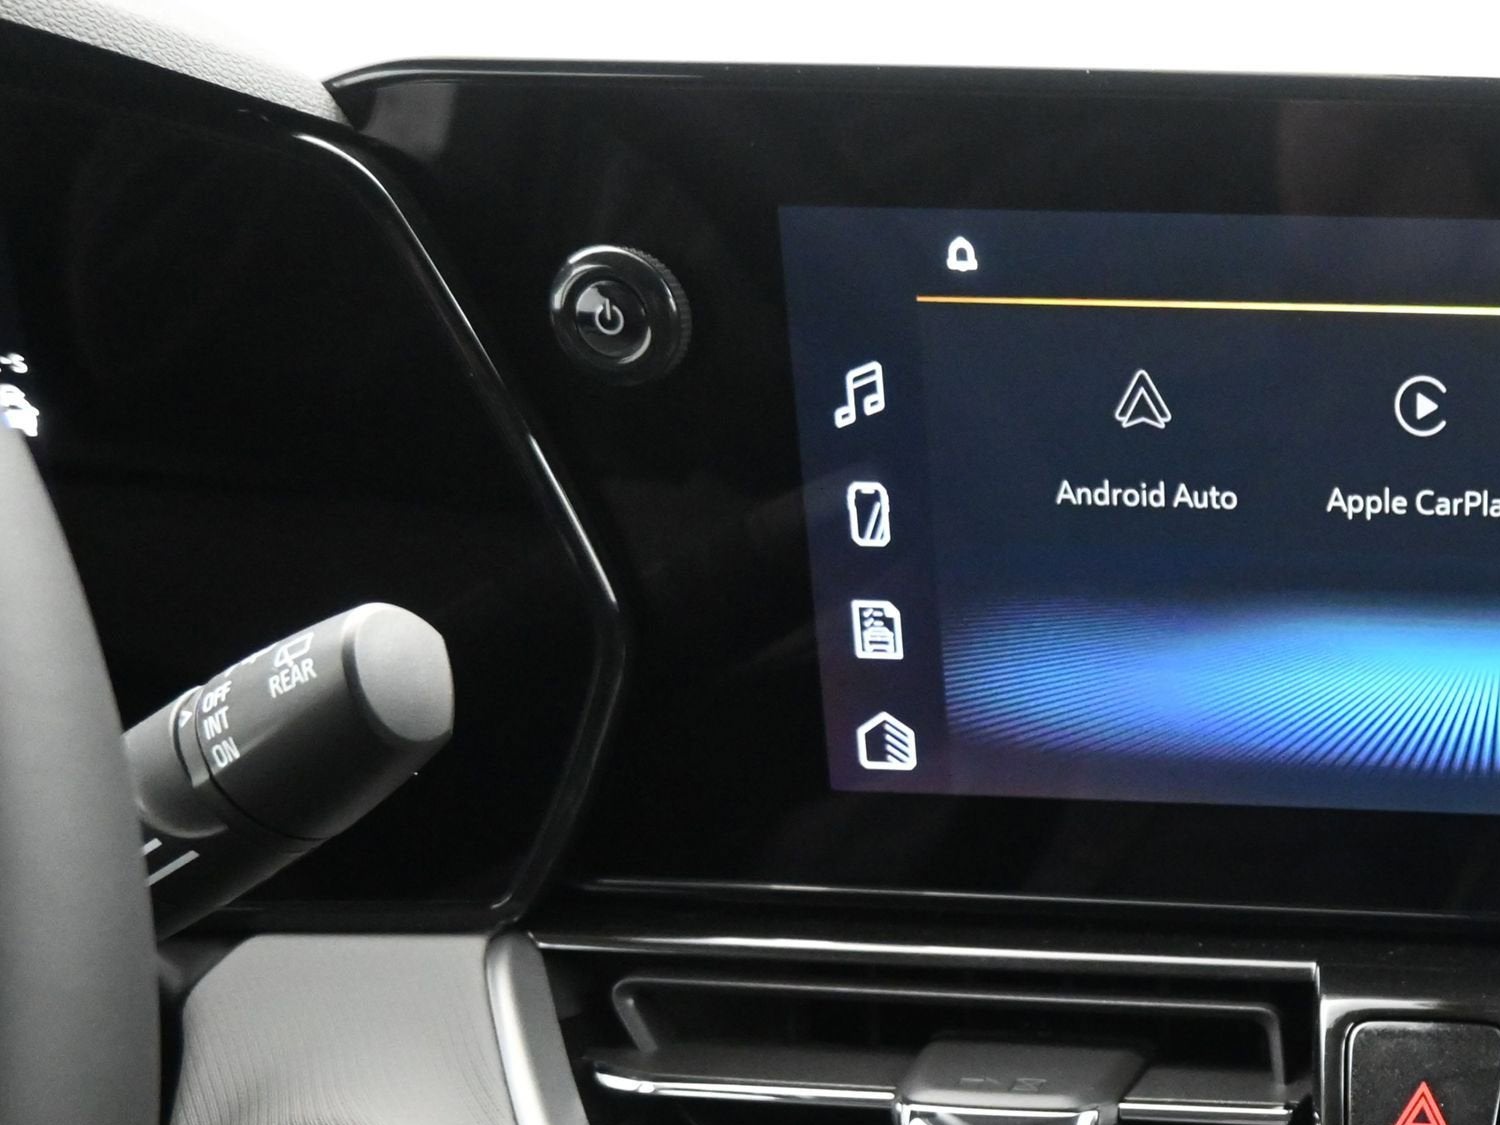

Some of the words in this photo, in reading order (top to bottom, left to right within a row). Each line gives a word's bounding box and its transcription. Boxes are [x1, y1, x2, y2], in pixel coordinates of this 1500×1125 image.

[1055, 477, 1166, 511] Android
[1172, 481, 1239, 512] Auto
[1325, 487, 1408, 521] Apple
[268, 658, 318, 699] REAR
[201, 680, 233, 714] OFF
[202, 706, 230, 741] INT
[211, 736, 241, 769] ON
